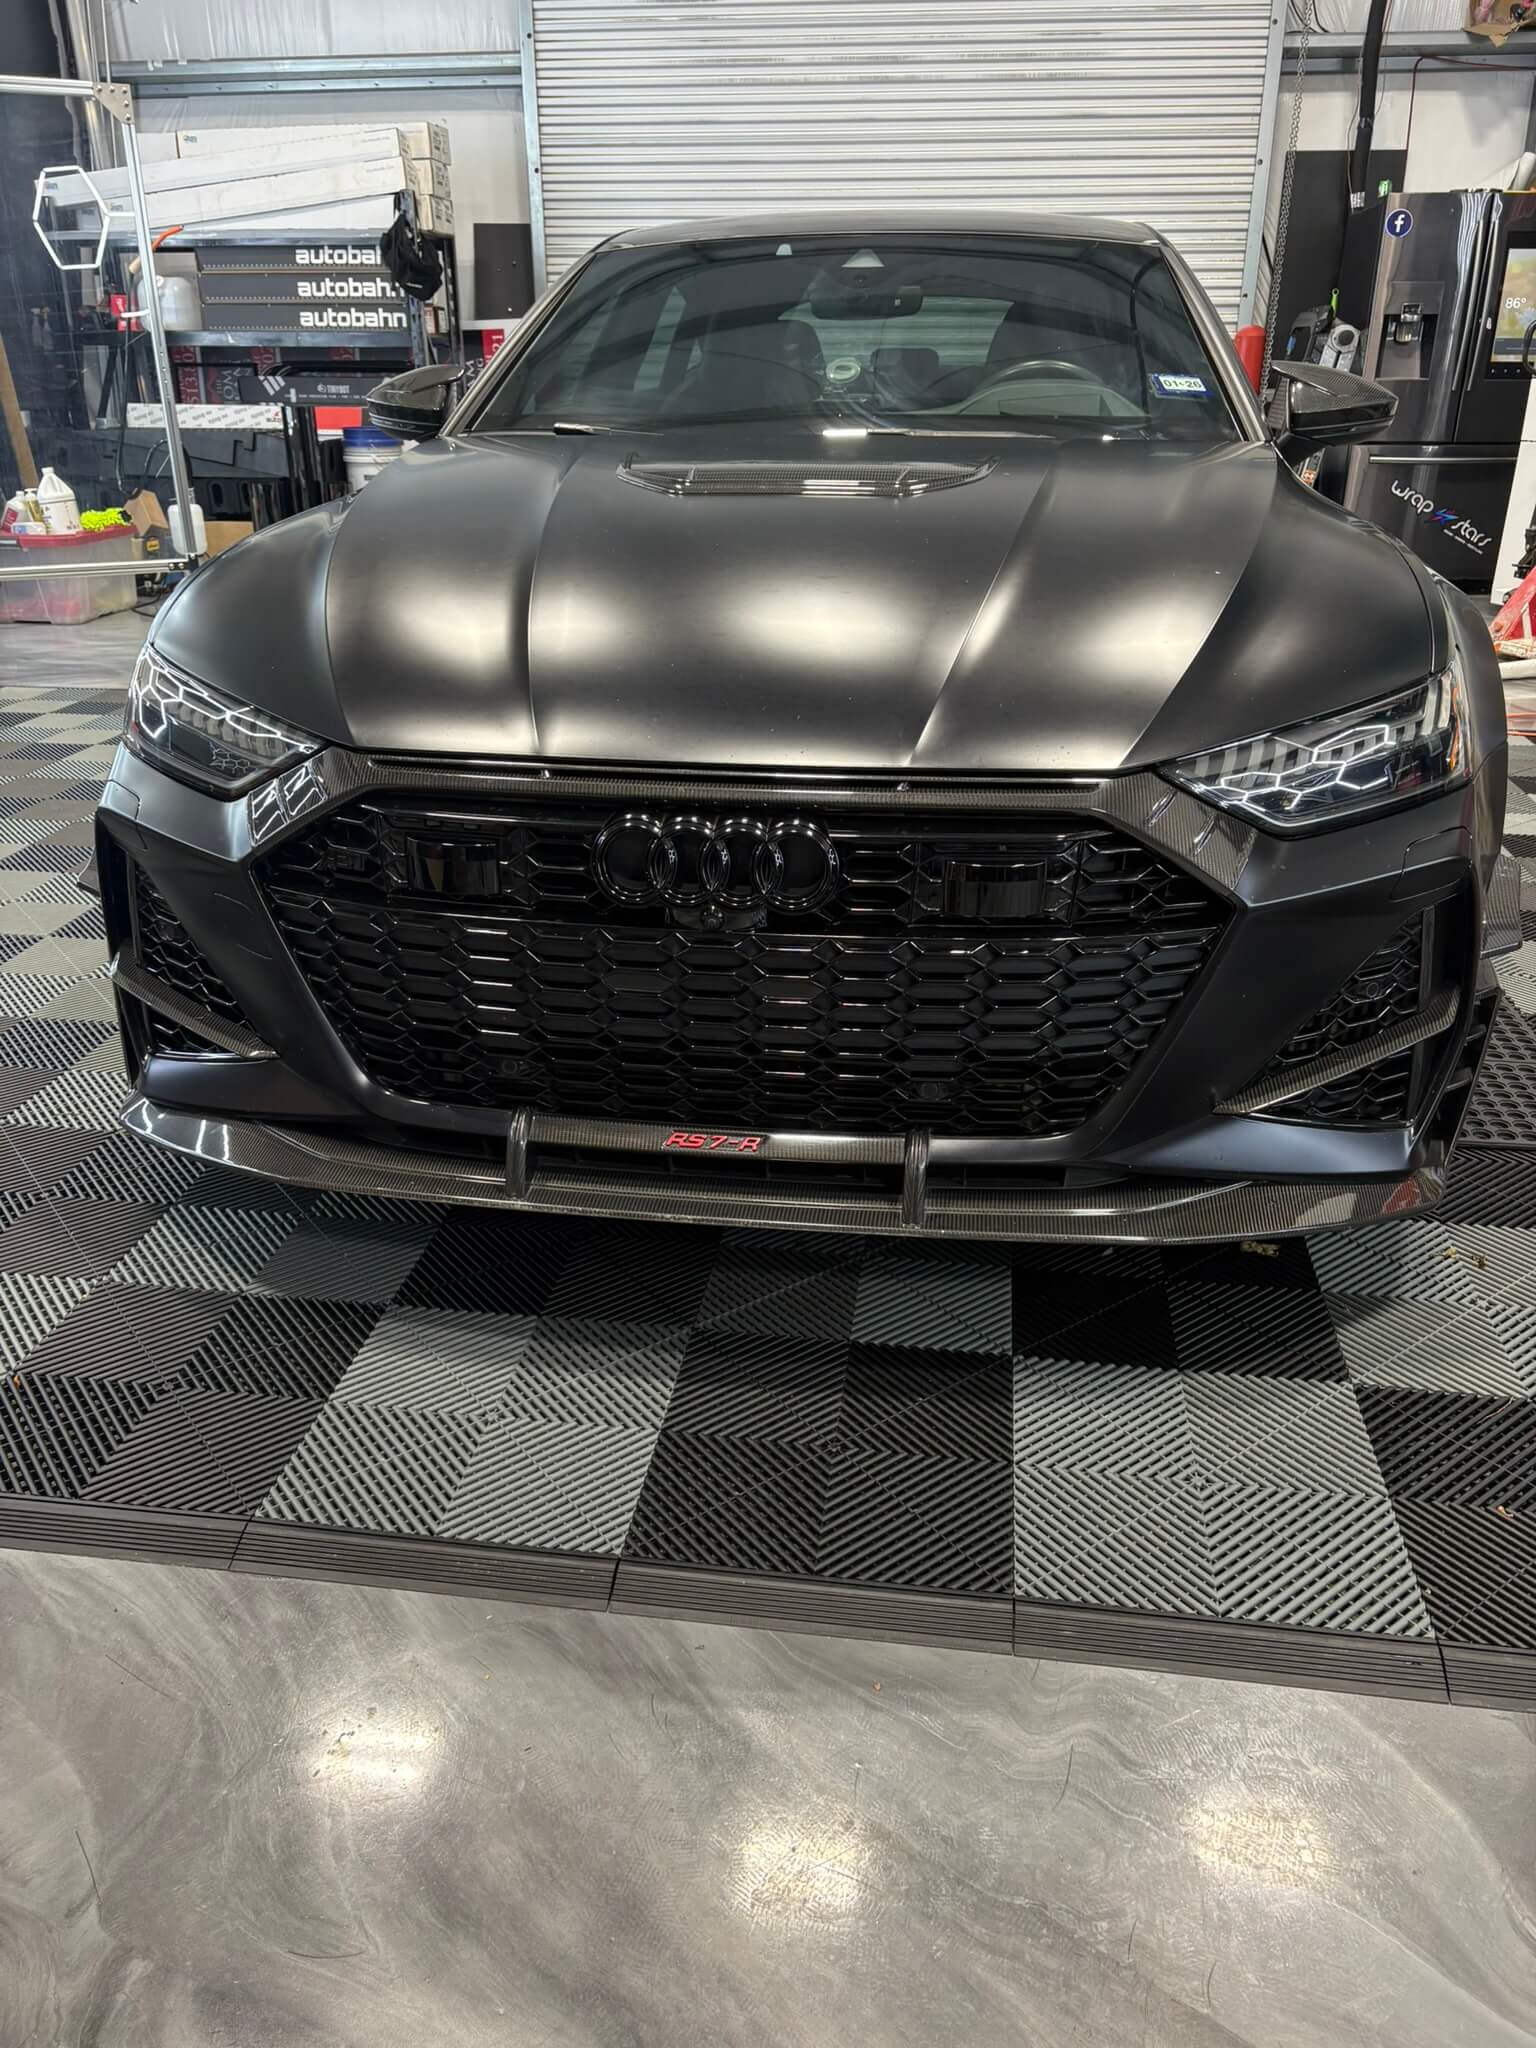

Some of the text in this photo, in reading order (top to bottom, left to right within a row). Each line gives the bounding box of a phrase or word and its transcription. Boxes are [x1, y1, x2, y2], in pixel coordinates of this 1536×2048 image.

[299, 308, 408, 328] autobahn
[1391, 479, 1434, 514] wrap
[1451, 519, 1493, 547] stars
